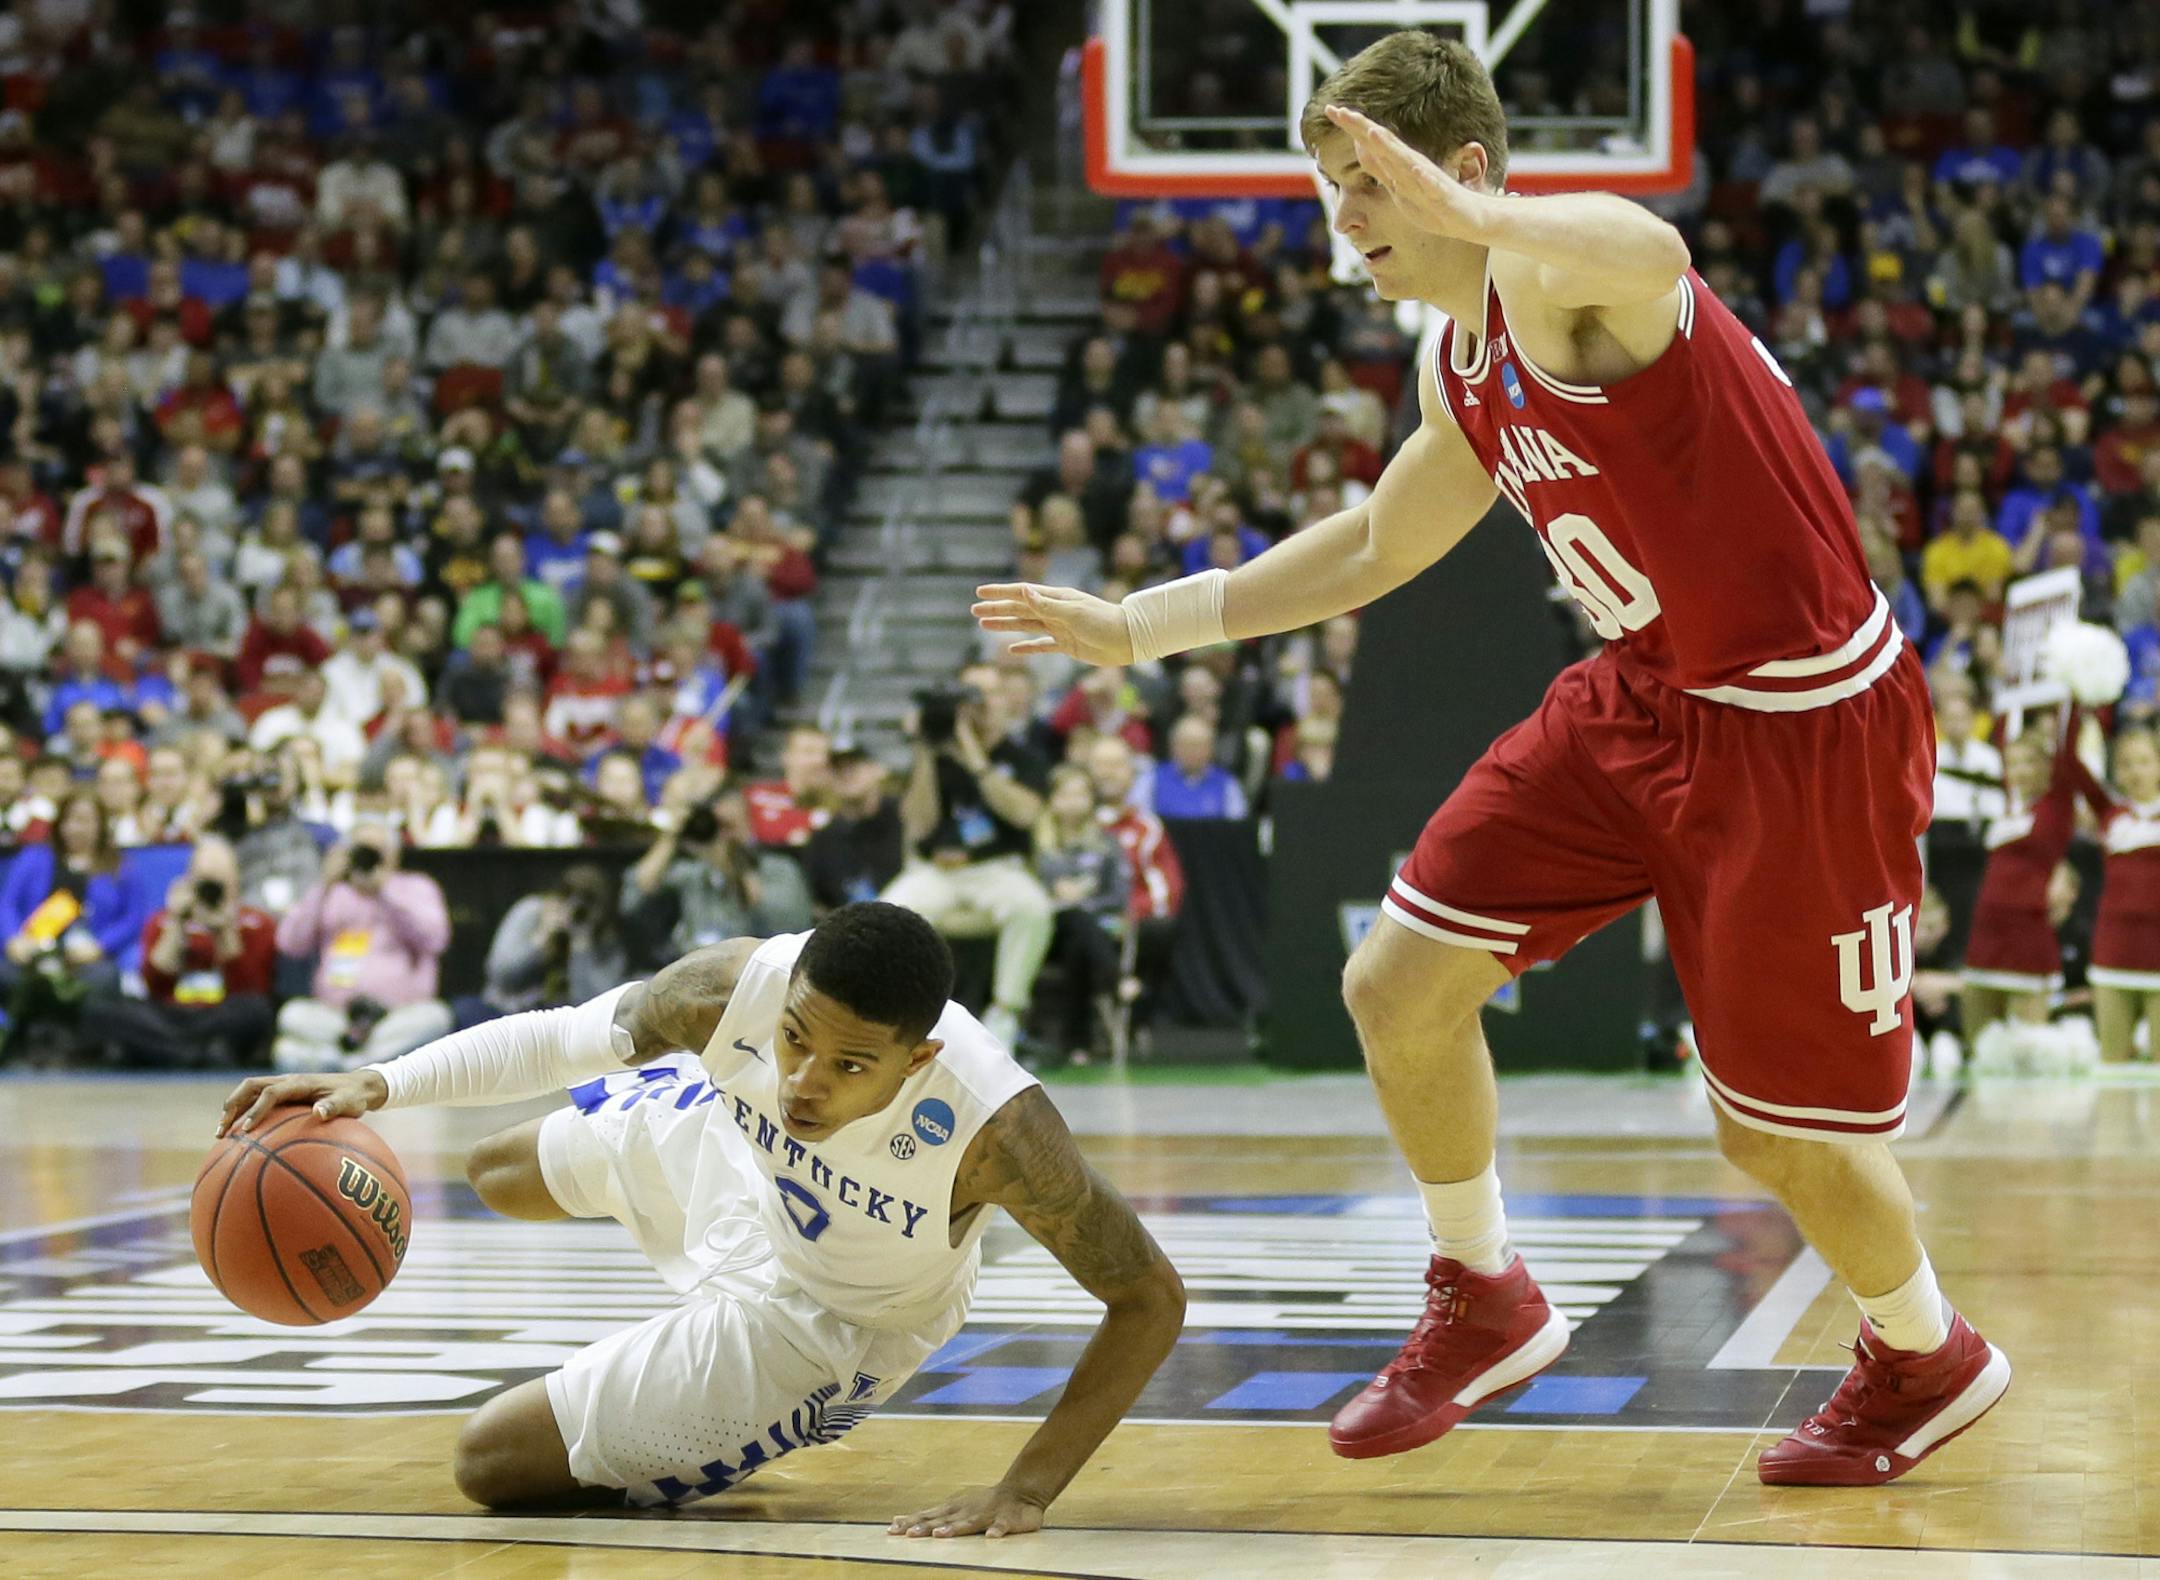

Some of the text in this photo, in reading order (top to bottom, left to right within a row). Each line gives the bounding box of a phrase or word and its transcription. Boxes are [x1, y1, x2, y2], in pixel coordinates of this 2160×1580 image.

[1831, 901, 1913, 1036] IU
[709, 1076, 928, 1239] ENTUCKY
[891, 1134, 915, 1159] SEC
[337, 1156, 406, 1262] Wilso
